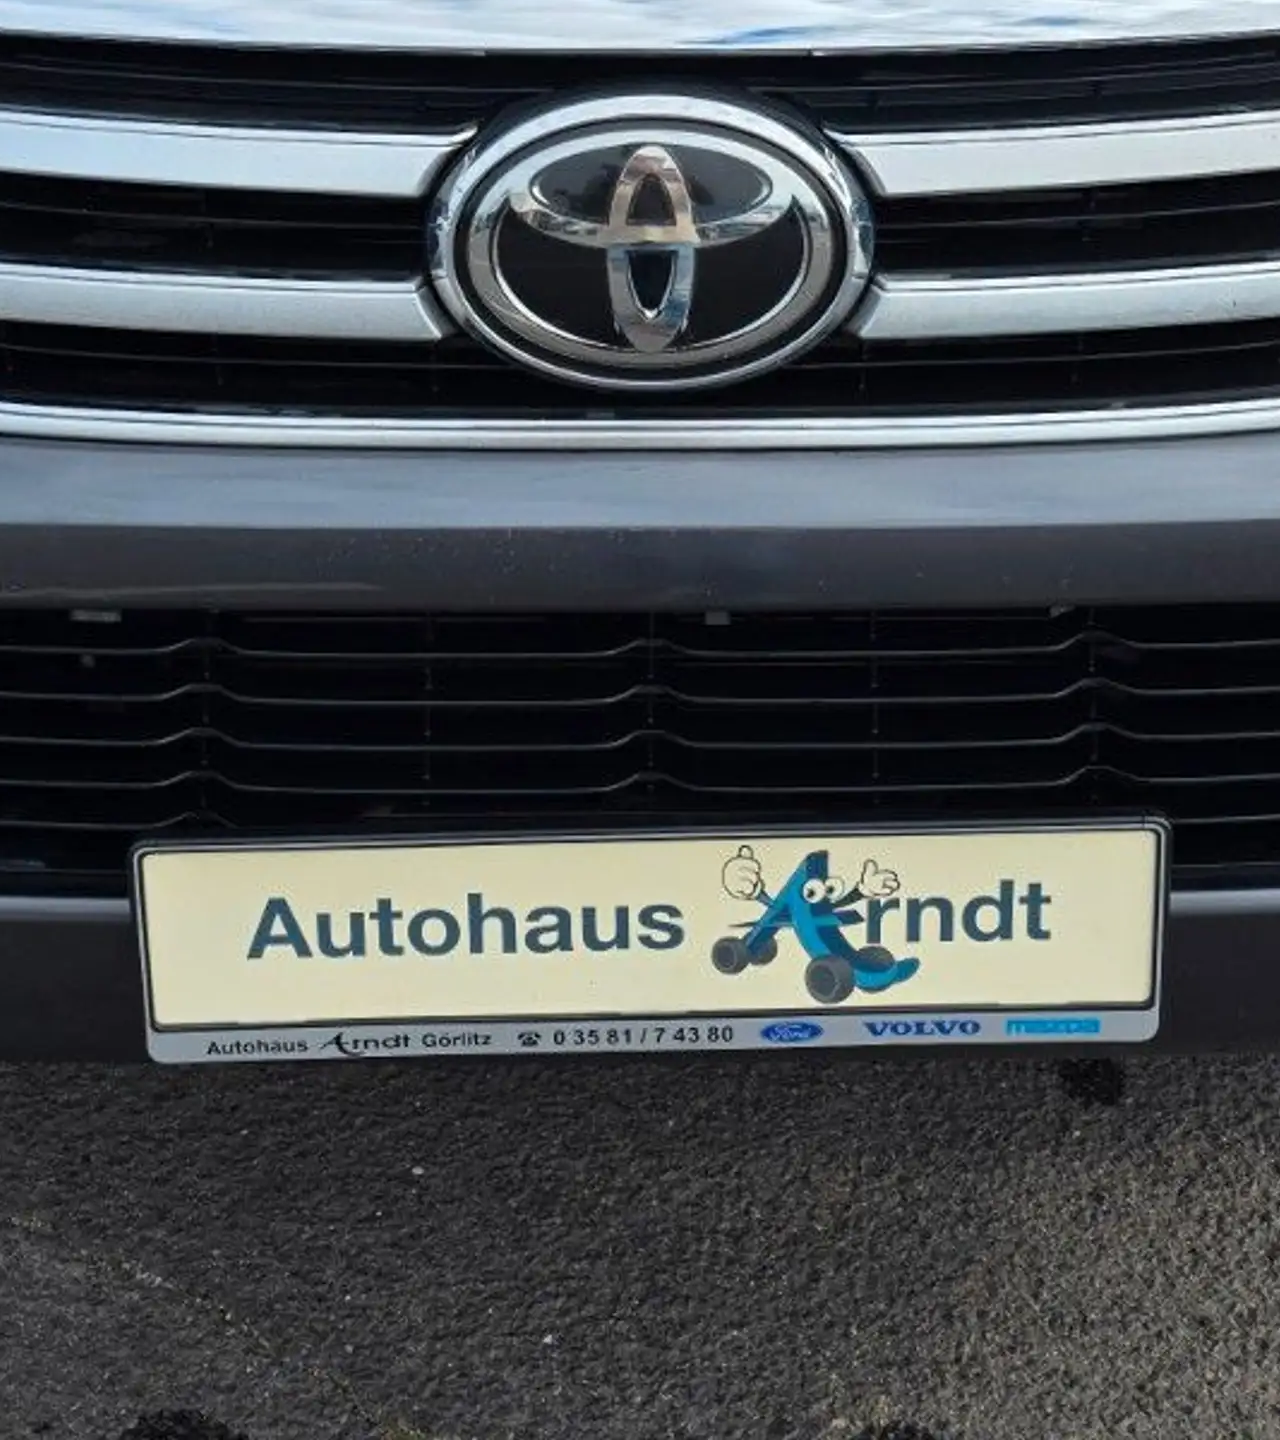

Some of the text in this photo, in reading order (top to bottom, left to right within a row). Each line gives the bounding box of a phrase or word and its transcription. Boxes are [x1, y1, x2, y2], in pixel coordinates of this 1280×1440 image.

[246, 846, 1053, 1004] Autohaus Arndt
[206, 1039, 309, 1056] Autohaus
[320, 1031, 412, 1058] Arndt
[421, 1030, 493, 1049] Görlitz
[864, 1019, 982, 1037] VOLVO
